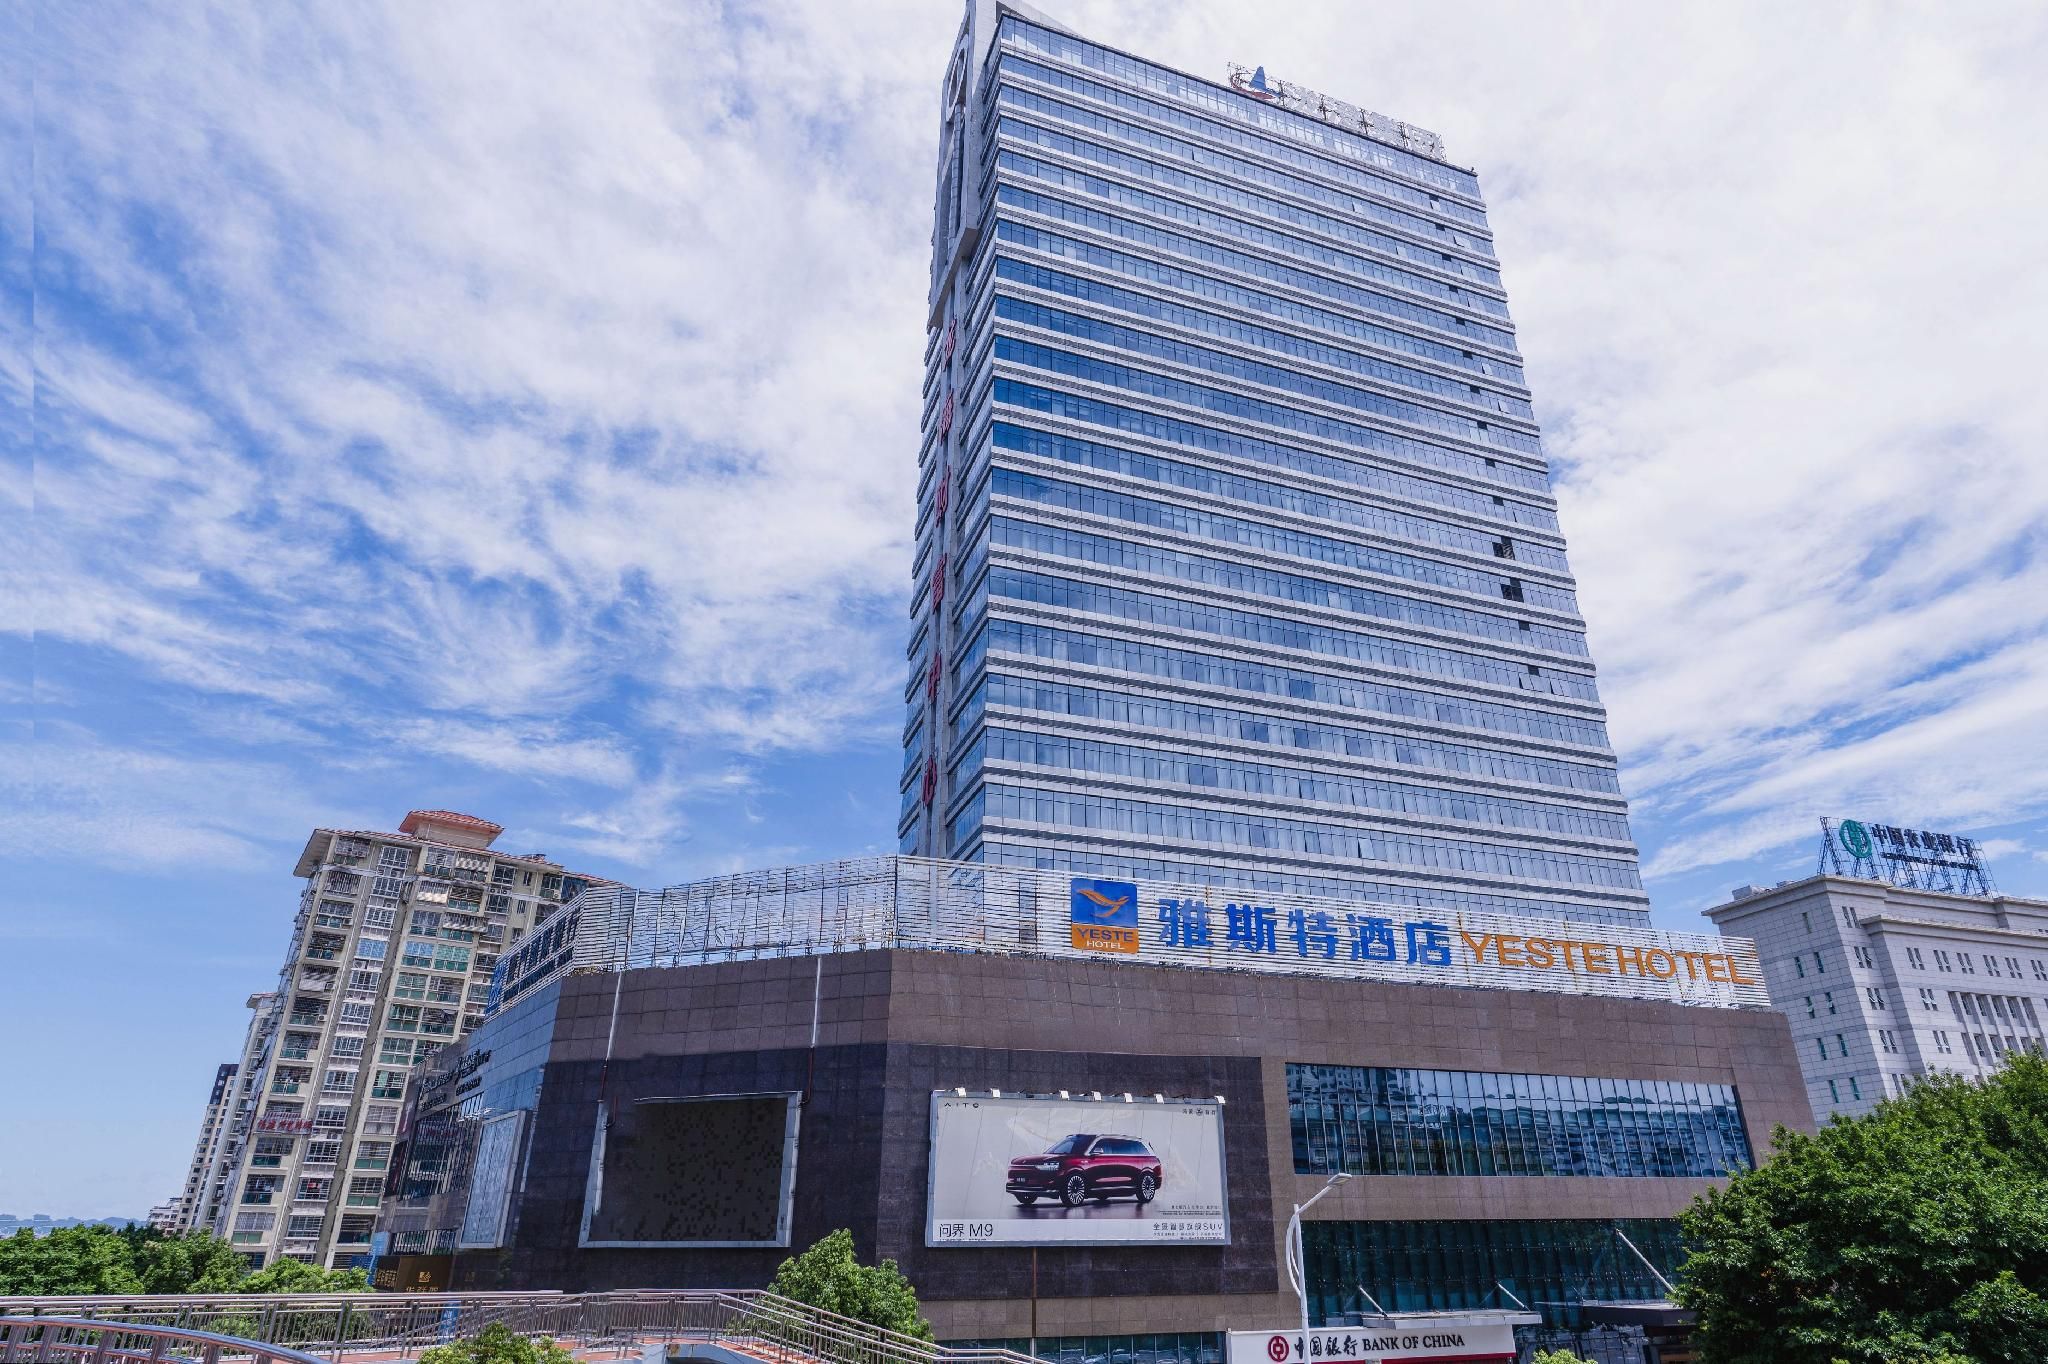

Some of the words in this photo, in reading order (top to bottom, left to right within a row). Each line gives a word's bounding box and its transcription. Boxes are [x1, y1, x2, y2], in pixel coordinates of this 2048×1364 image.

[1077, 927, 1134, 942] YESTE
[1159, 898, 1452, 967] 雅斯特酒店
[1086, 940, 1126, 950] HOTEL
[1460, 931, 1611, 973] YESTE
[1616, 945, 1755, 985] HOTEL
[939, 1223, 965, 1238] 问界
[969, 1223, 993, 1237] M9
[1362, 1337, 1401, 1351] BANK
[1402, 1336, 1419, 1349] OF
[1423, 1334, 1466, 1348] CHINA
